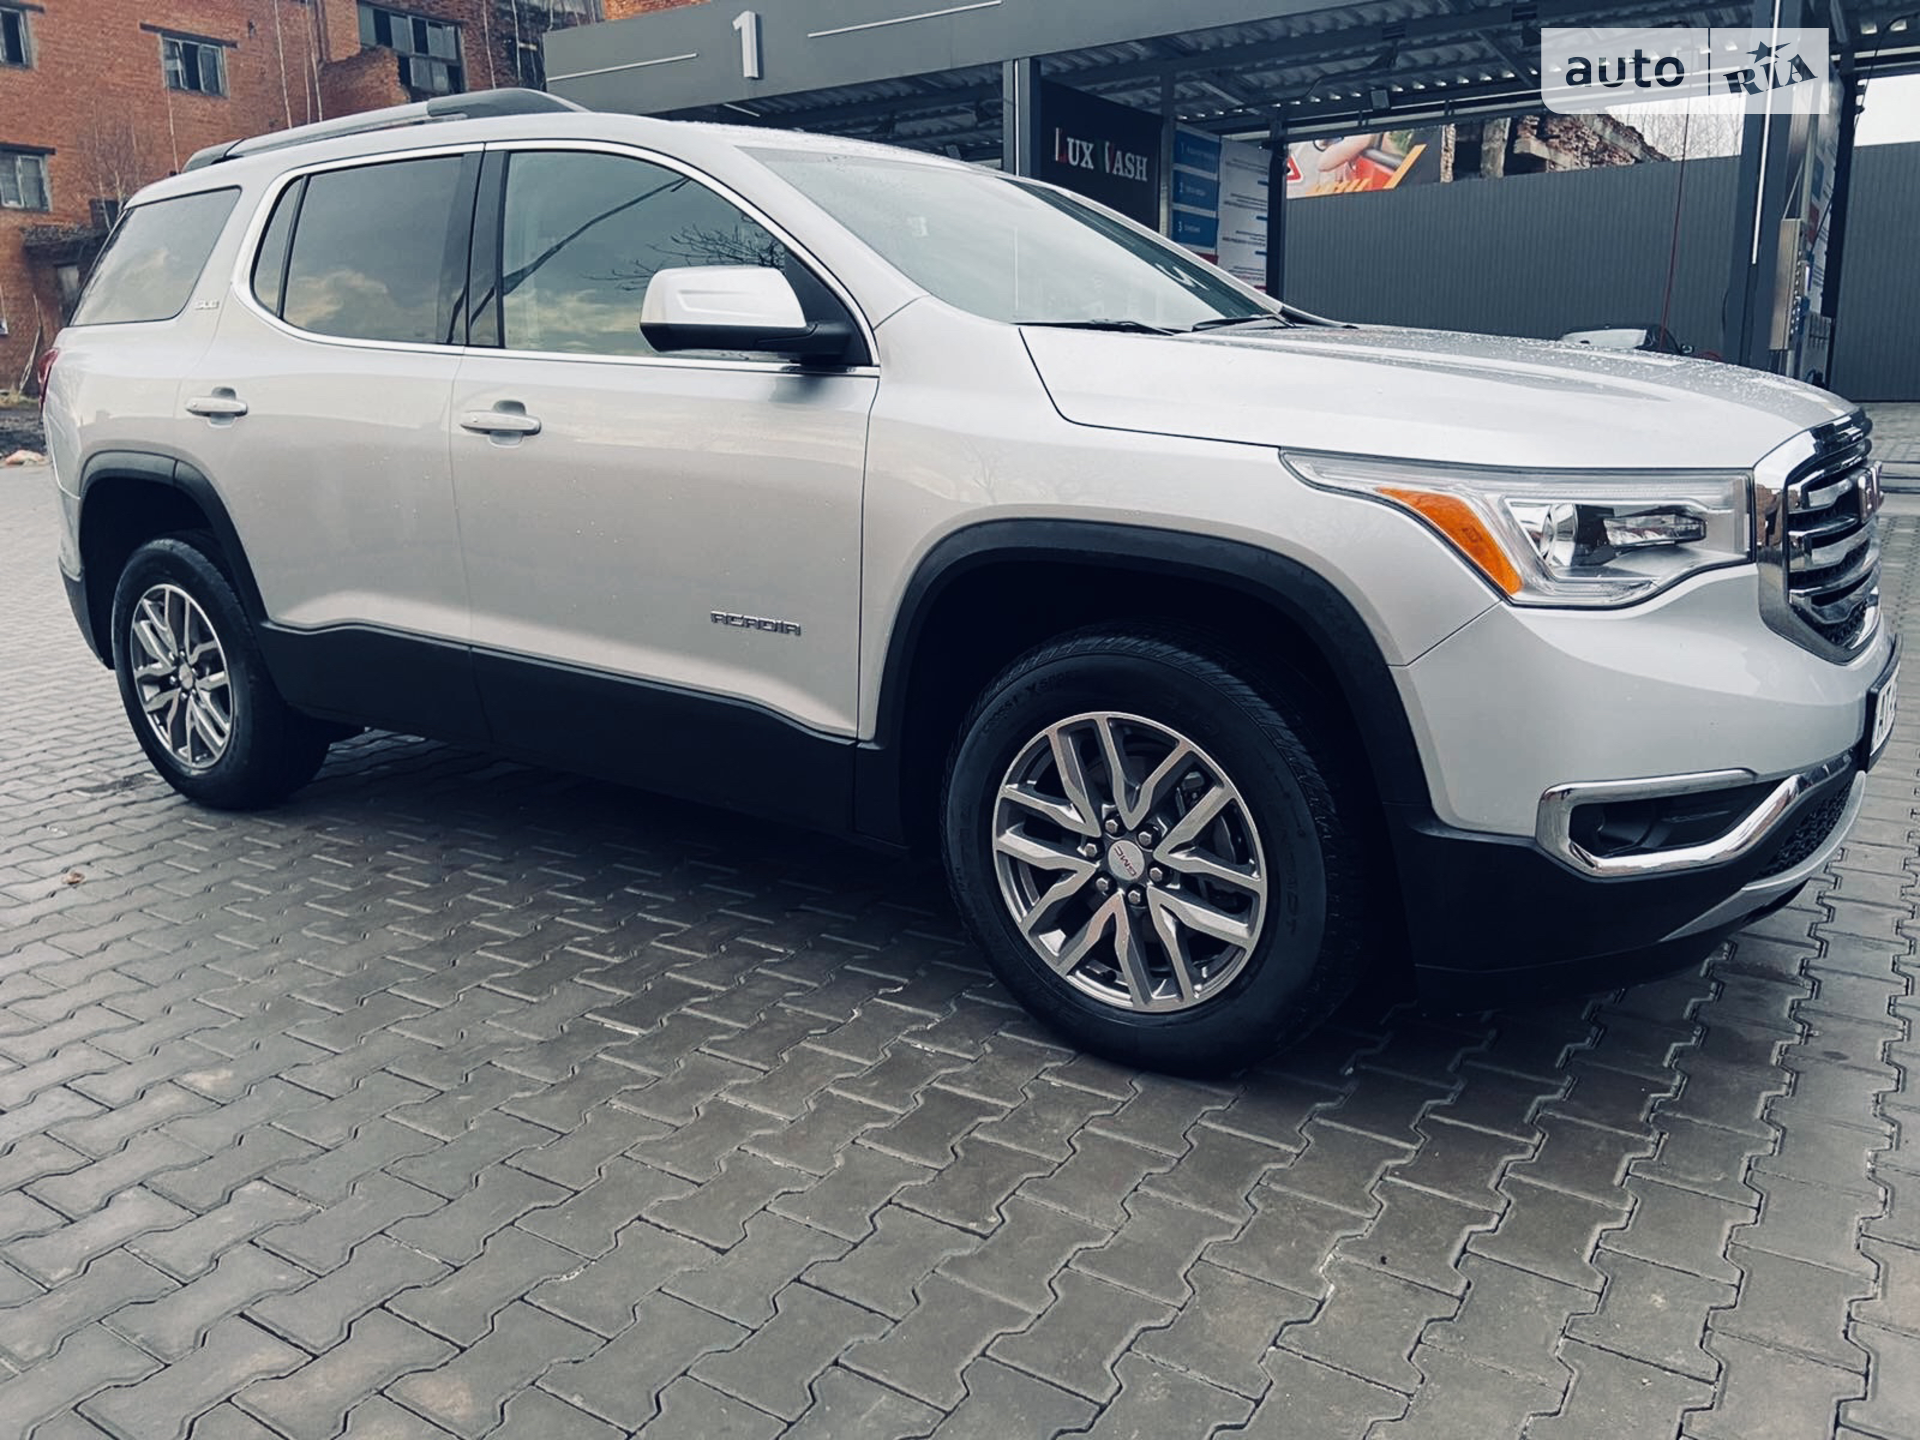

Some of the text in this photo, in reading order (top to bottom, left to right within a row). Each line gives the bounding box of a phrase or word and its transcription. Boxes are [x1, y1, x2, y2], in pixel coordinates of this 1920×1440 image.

[732, 10, 760, 79] 1
[1055, 127, 1148, 182] LUX WASH
[710, 610, 802, 636] ACADIA
[1114, 845, 1138, 877] GMC
